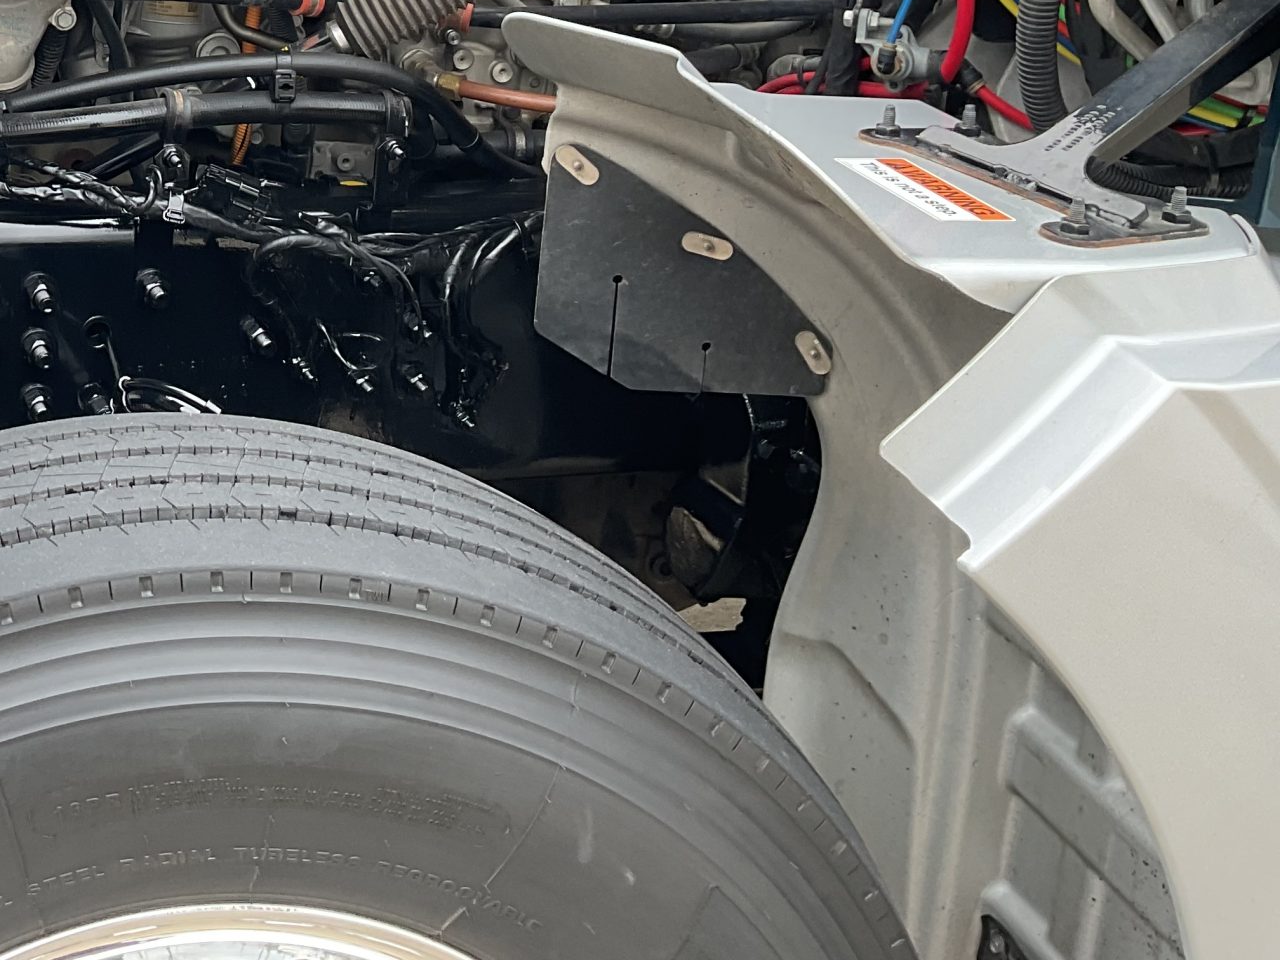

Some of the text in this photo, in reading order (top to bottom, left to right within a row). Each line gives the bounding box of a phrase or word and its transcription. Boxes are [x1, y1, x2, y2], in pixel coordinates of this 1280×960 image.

[860, 162, 888, 175] This
[898, 169, 996, 215] WARNING
[27, 865, 105, 896] STEEL
[119, 848, 216, 872] RADIAL
[232, 846, 361, 865] TUBELESS
